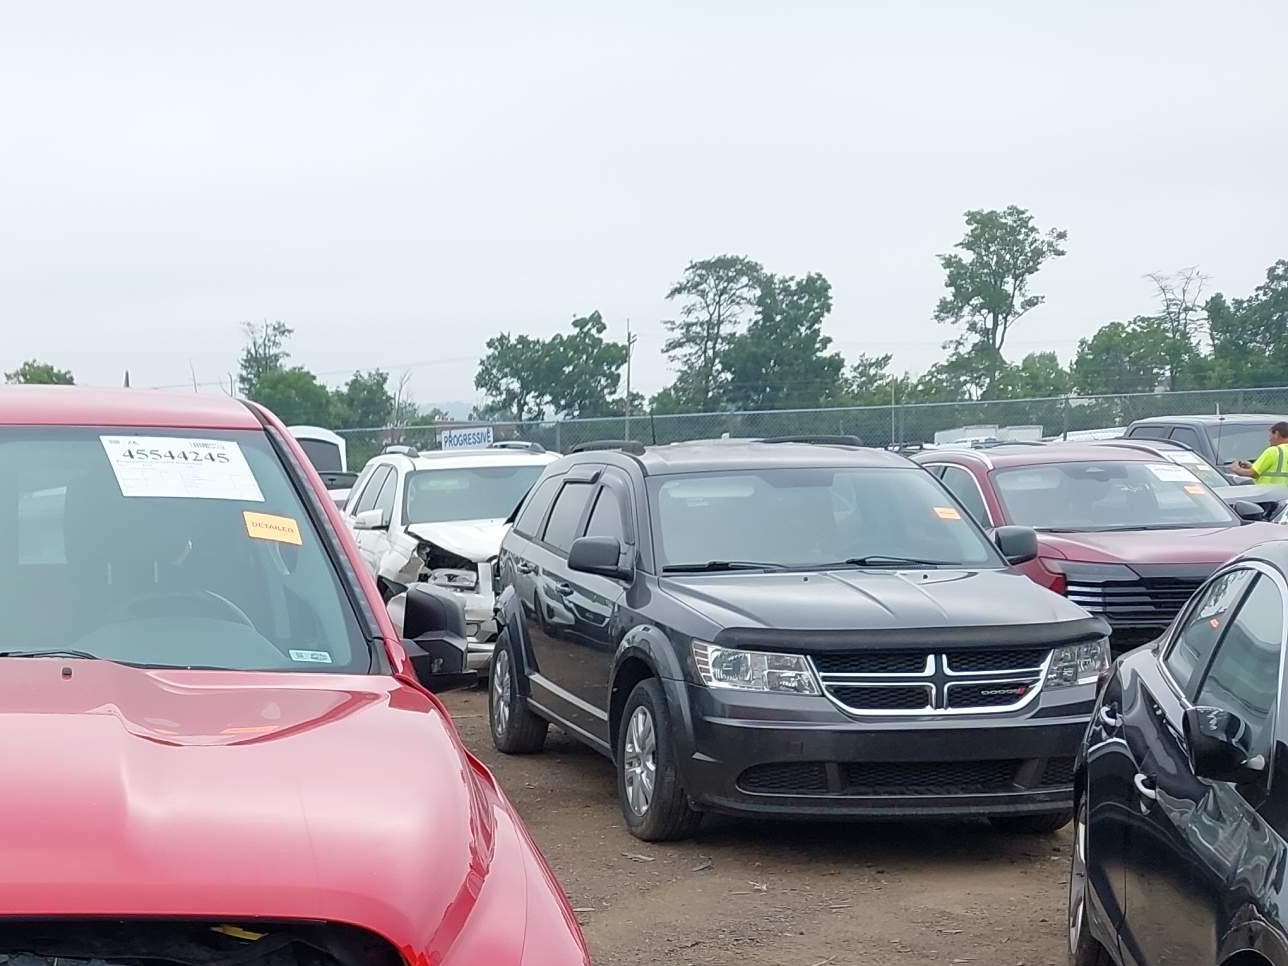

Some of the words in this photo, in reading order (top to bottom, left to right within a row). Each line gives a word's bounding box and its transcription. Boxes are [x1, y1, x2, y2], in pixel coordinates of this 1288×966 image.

[444, 430, 491, 448] PROGRESSIVE
[122, 449, 230, 463] 45544245
[251, 521, 295, 533] DETAILED
